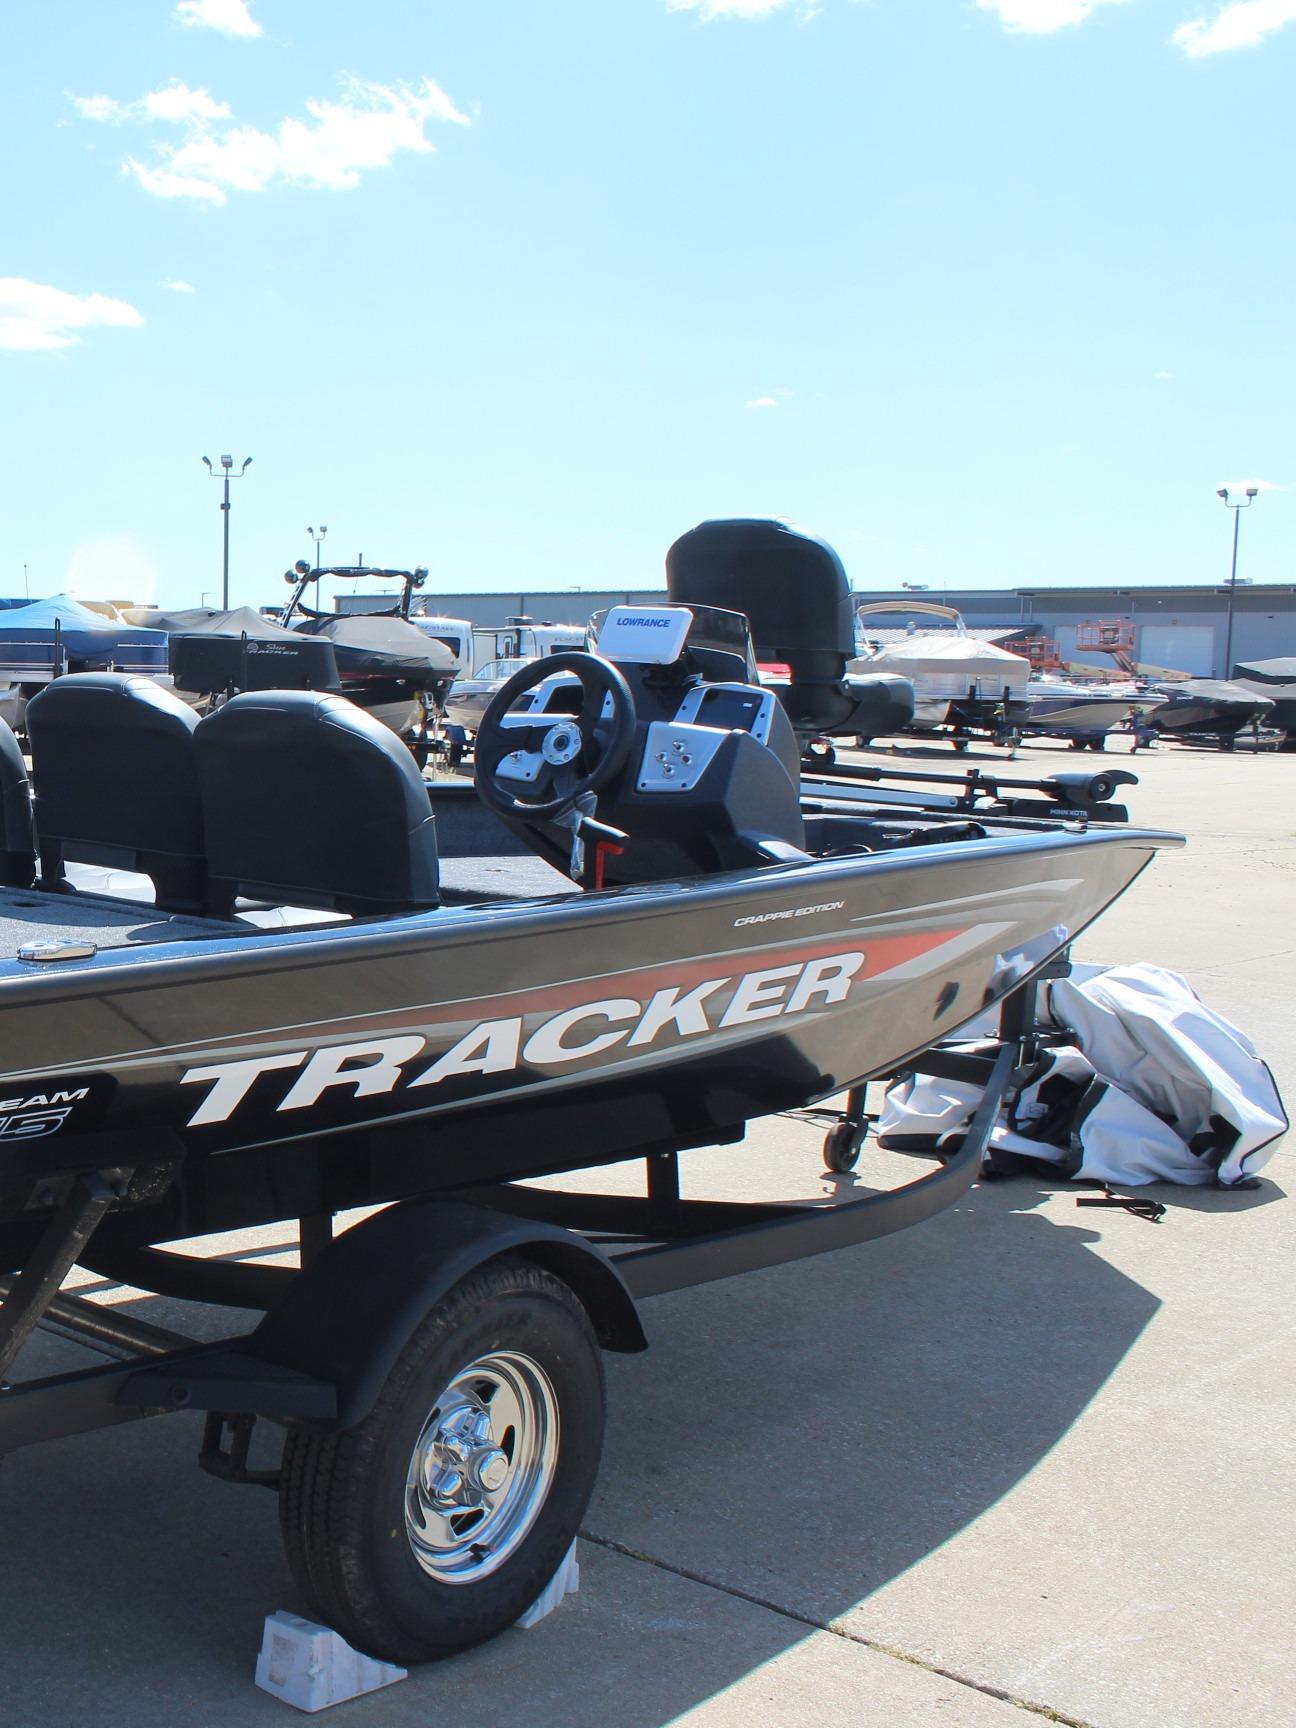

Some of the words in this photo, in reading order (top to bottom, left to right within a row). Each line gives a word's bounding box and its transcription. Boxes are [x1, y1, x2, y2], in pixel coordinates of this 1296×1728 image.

[616, 617, 671, 628] LOWRANCE
[733, 909, 795, 927] CRAPPIE
[794, 900, 845, 917] EDITION
[179, 952, 866, 1127] TRACKER
